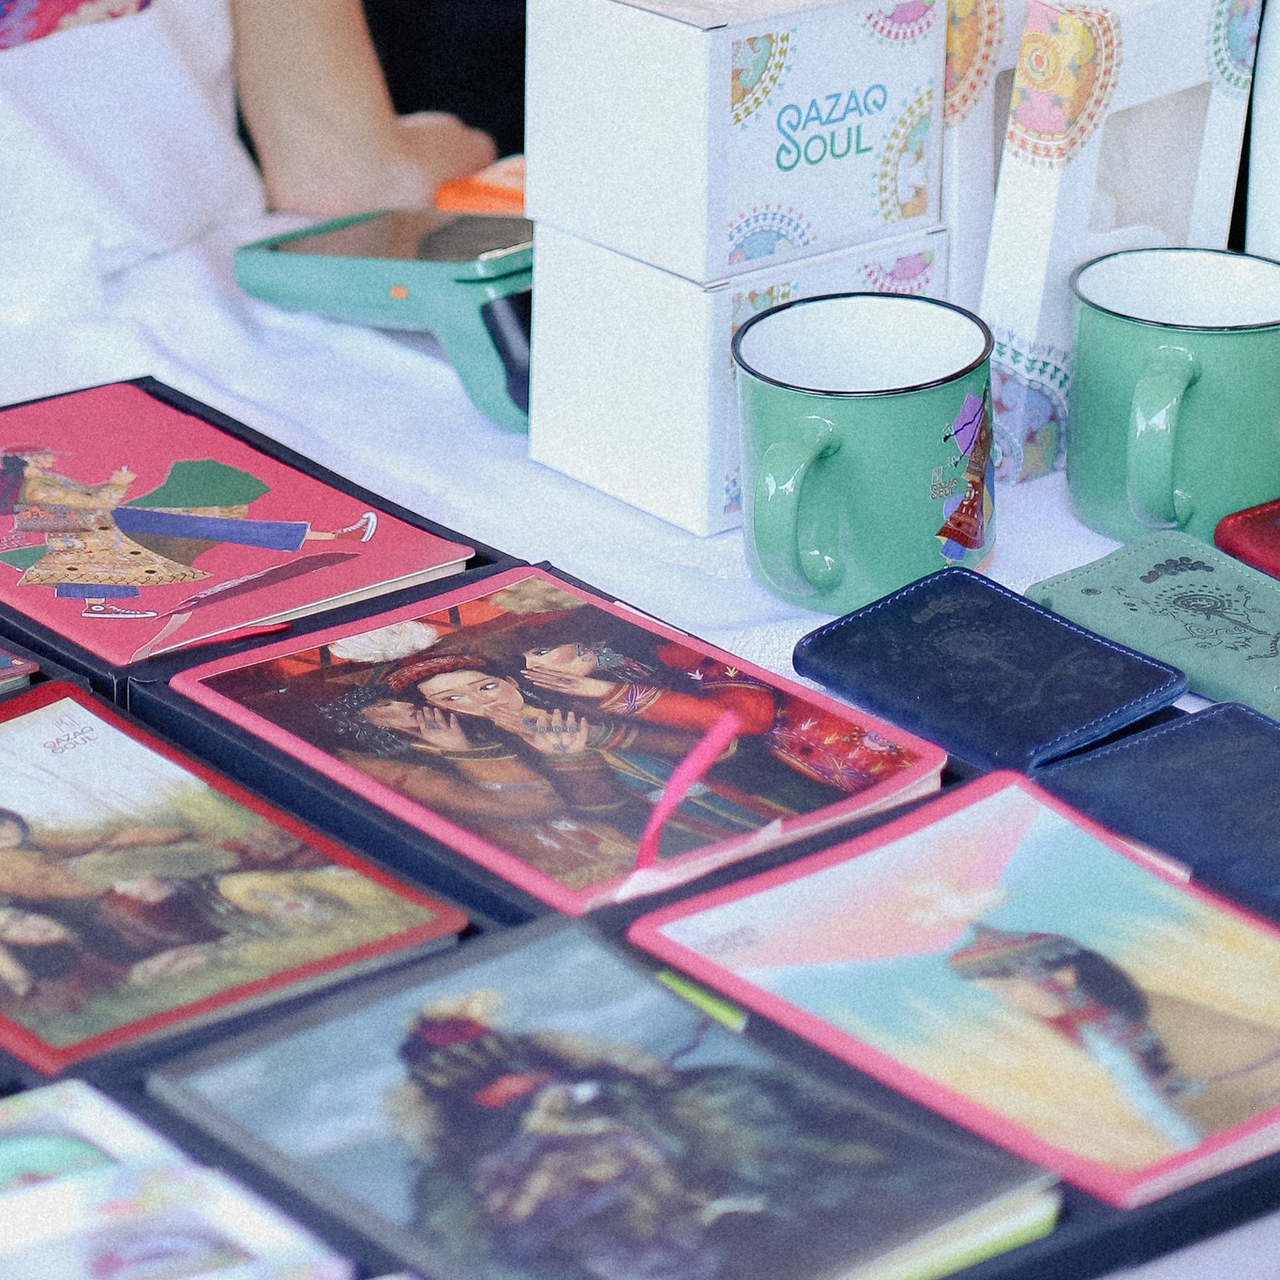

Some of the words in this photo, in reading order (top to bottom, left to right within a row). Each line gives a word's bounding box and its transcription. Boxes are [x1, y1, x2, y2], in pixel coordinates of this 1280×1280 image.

[776, 84, 887, 135] QAZAQ
[776, 124, 873, 172] SOUL
[43, 725, 95, 749] QAZAQ
